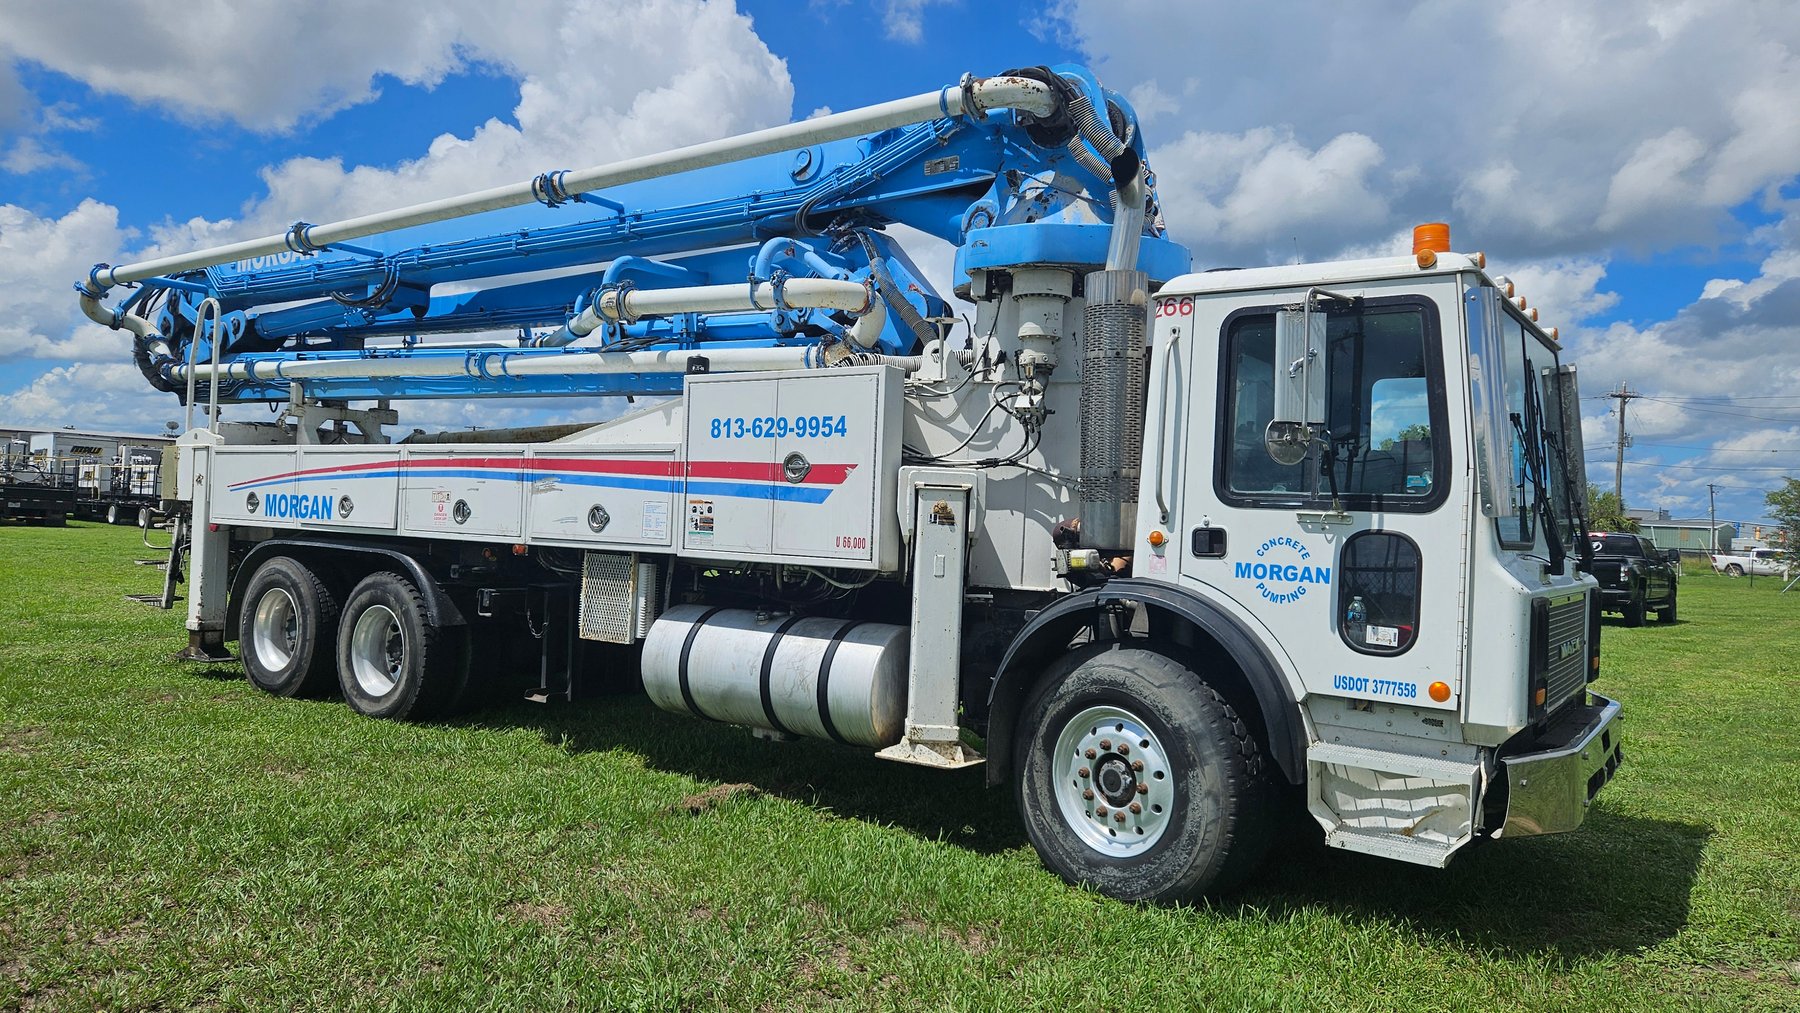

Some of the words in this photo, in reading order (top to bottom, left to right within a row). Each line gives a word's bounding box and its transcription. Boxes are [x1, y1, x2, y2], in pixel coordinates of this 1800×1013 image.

[1155, 296, 1193, 318] 266
[710, 415, 847, 438] 813-629-9954
[264, 493, 333, 520] MORGAN
[843, 536, 866, 550] 66,000
[1256, 536, 1311, 560] CONCRETE
[1234, 562, 1331, 585] MORGAN
[1255, 582, 1307, 604] PUMPING
[1333, 674, 1369, 693] USDOT
[1372, 679, 1417, 698] 3777558
